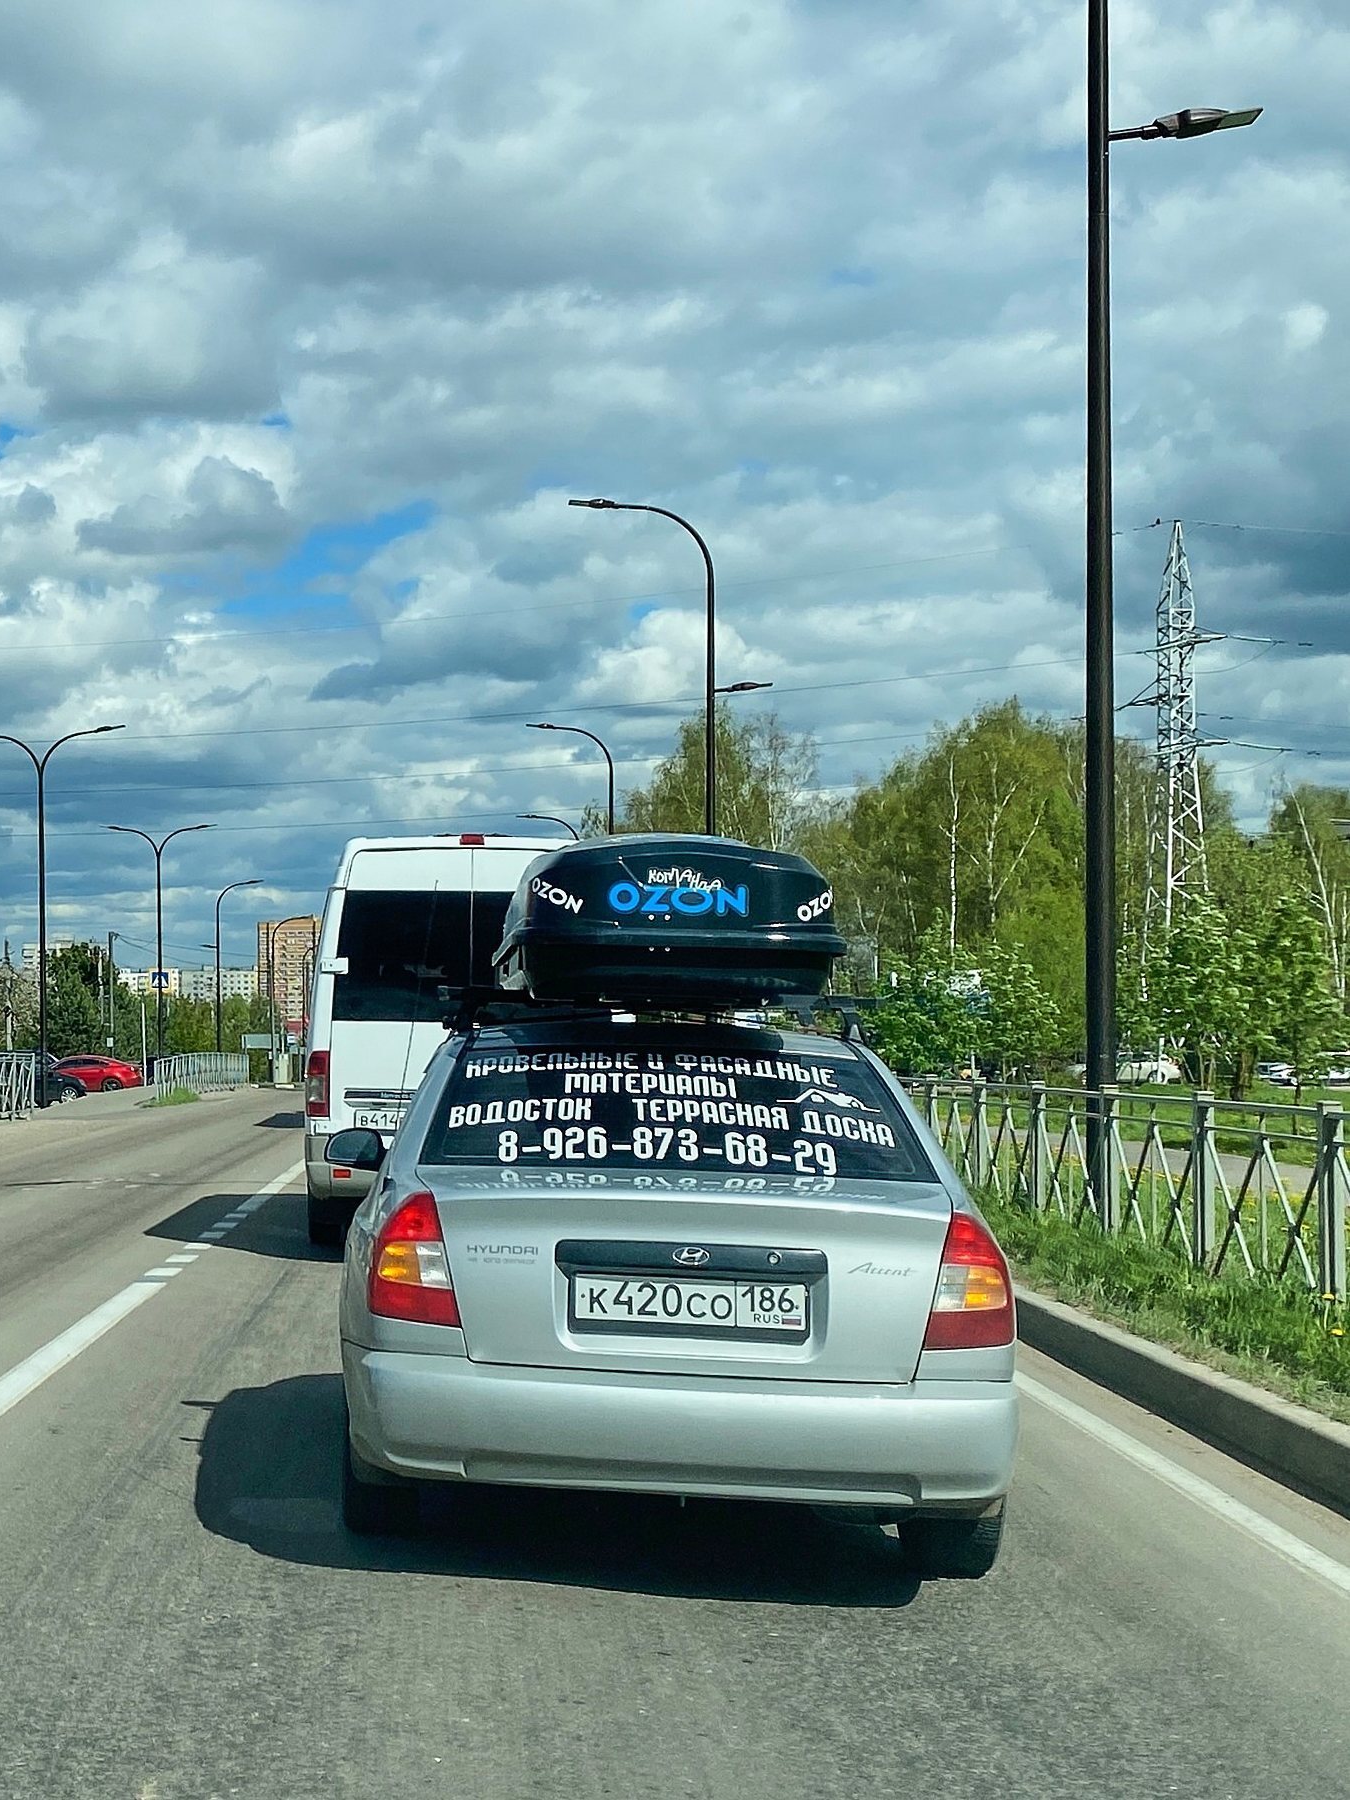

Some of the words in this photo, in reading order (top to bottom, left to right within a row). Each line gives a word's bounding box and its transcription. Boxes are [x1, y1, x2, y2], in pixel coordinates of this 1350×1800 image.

[531, 877, 583, 914] OZON
[608, 880, 748, 916] OZON
[466, 1052, 639, 1079] КРОВЕЛЬНЫЕ
[675, 1053, 838, 1088] ФАСАДНЫЕ
[564, 1072, 737, 1098] МАТЕРИАЛЫ
[360, 1112, 402, 1127] В414
[449, 1098, 592, 1128] ВОДОСТОК
[632, 1098, 790, 1131] ТЕРРАСНАЯ
[801, 1110, 896, 1148] ДОСКА
[498, 1126, 838, 1176] 8-926-873-68-29
[466, 1244, 539, 1256] HYUNDAI
[589, 1281, 733, 1319] К420СО
[741, 1285, 795, 1313] 186
[753, 1313, 781, 1325] RUS
